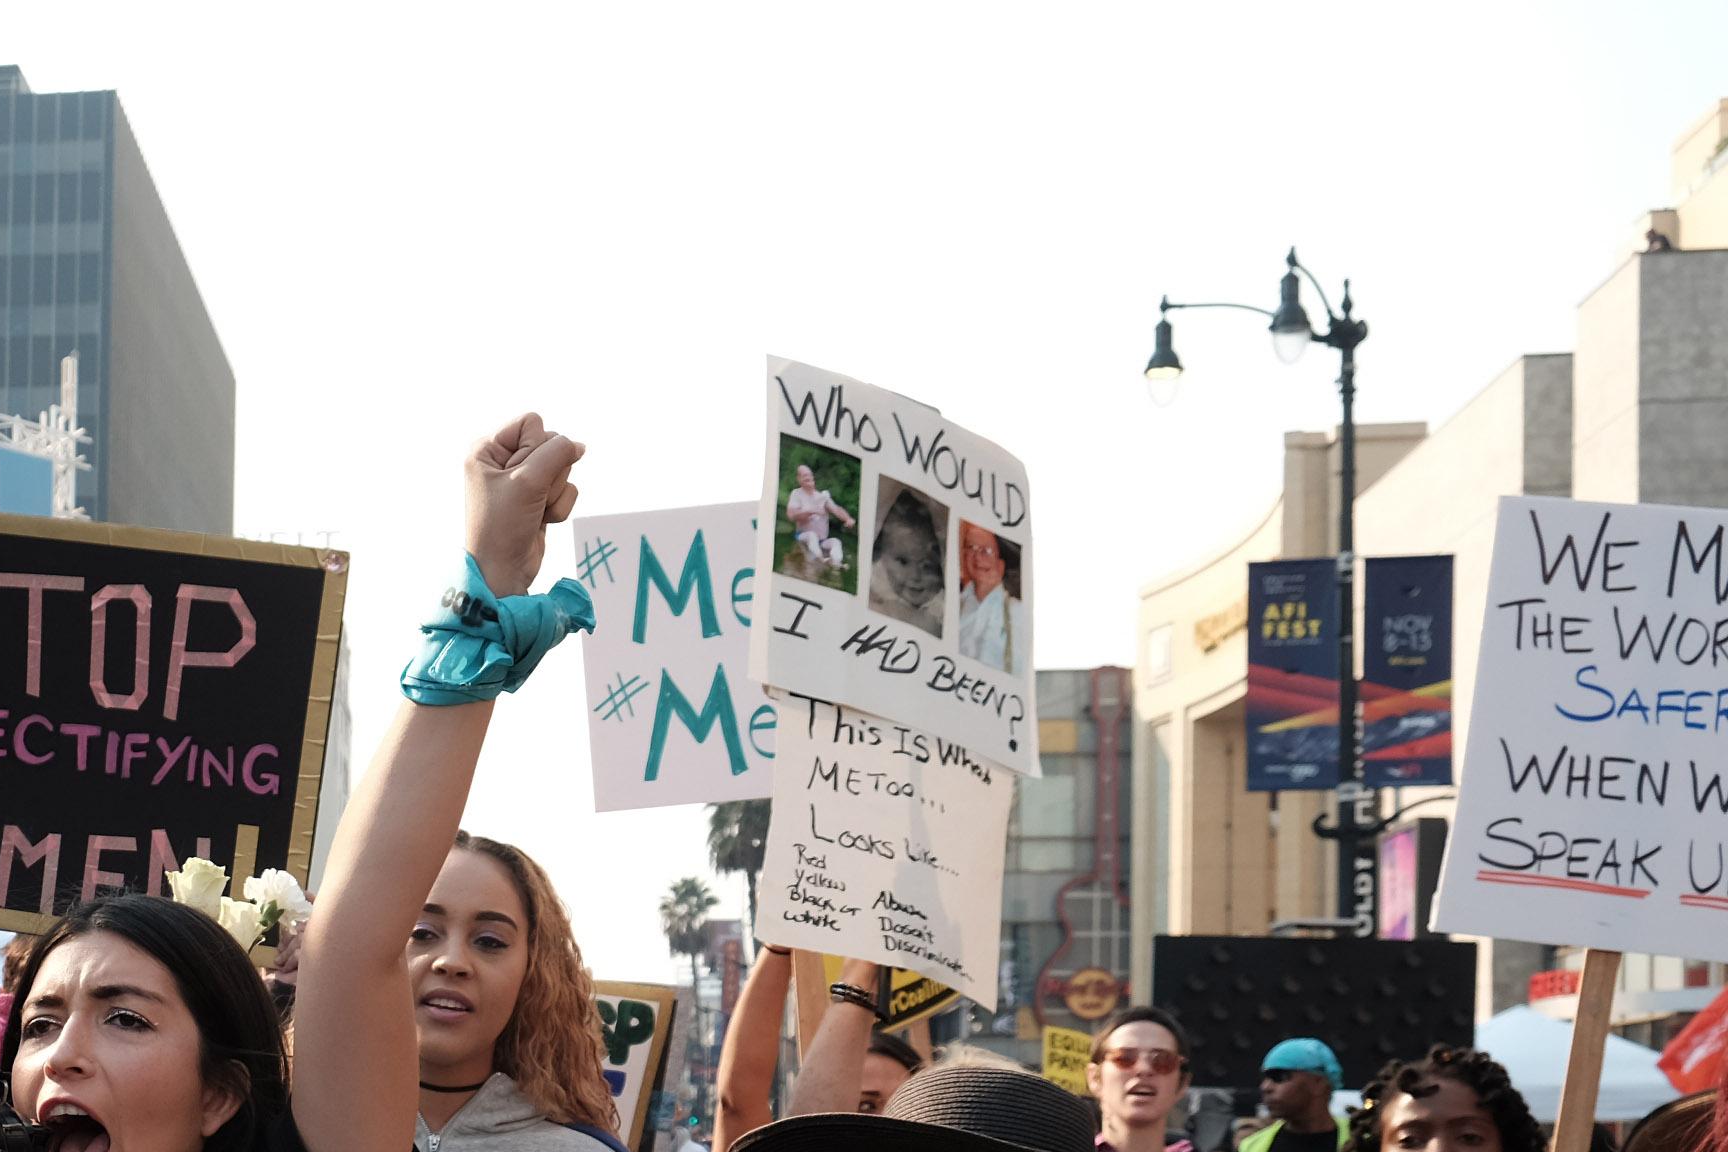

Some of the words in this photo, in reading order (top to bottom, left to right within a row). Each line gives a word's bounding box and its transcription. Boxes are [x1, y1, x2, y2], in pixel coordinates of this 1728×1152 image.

[1529, 508, 1640, 592] WE
[1666, 519, 1728, 606] M
[772, 591, 823, 640] I
[840, 624, 921, 674] HAD
[1262, 619, 1321, 639] FEST
[1498, 597, 1595, 654] THE
[1499, 736, 1671, 808] WHEN
[1478, 816, 1664, 888] SPEAK
